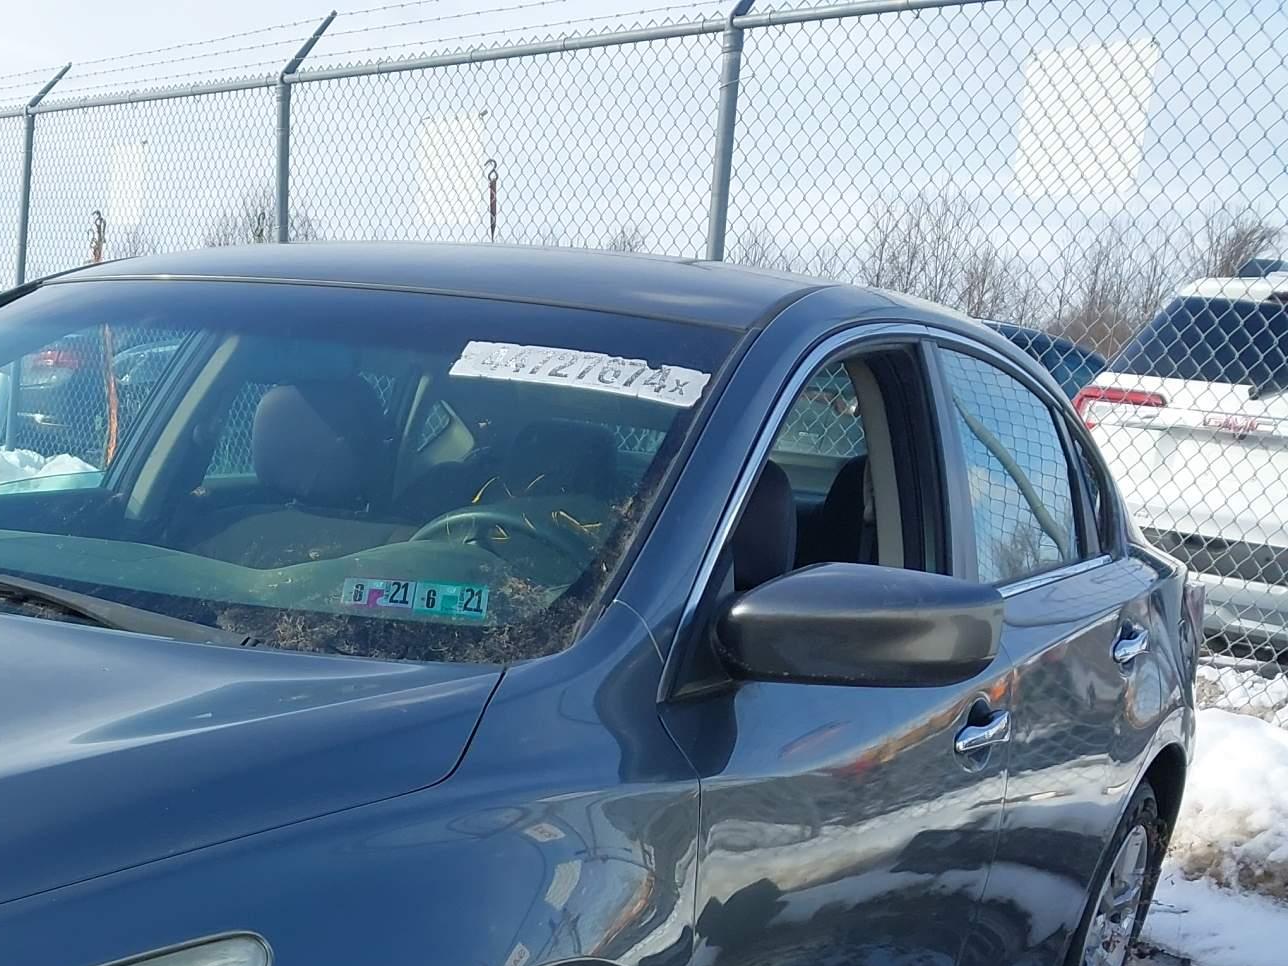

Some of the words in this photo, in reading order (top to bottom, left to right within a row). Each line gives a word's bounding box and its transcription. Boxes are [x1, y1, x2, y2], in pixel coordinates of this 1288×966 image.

[388, 581, 410, 605] 21
[425, 589, 437, 609] 6
[462, 588, 483, 613] 21
